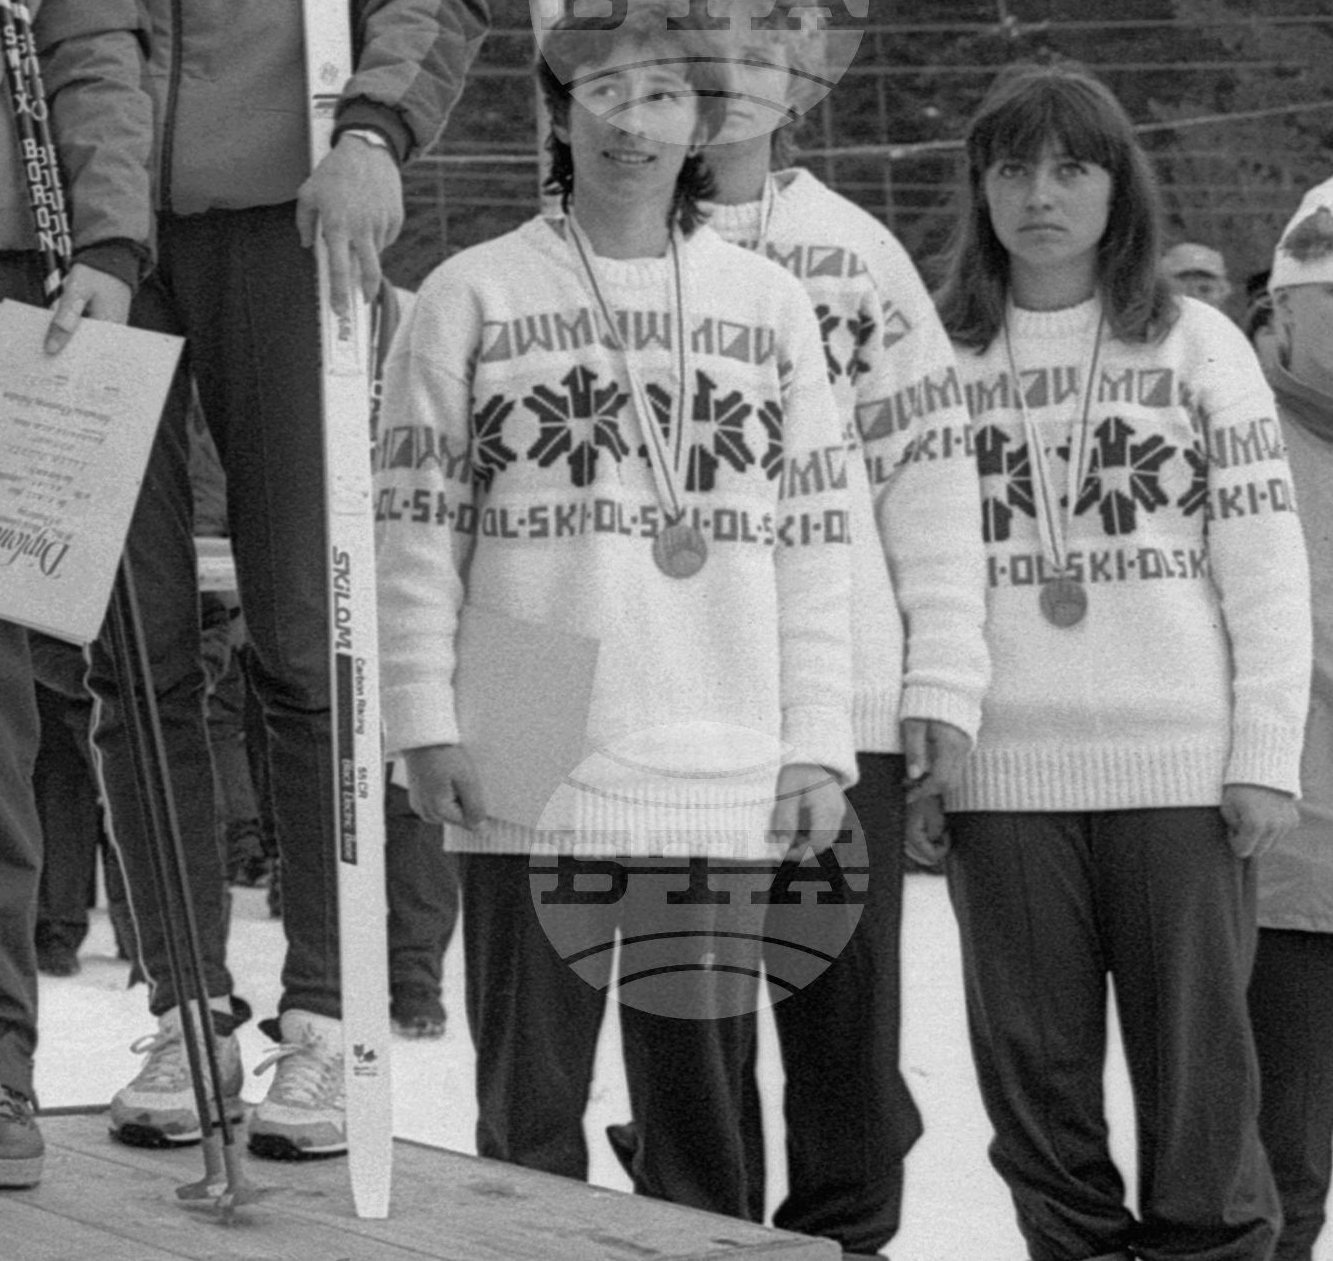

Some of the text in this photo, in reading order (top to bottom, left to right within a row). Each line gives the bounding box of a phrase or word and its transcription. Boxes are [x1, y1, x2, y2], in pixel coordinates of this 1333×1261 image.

[3, 24, 31, 114] SWIX
[23, 137, 55, 252] BORON
[355, 656, 367, 735] Carbon Racing
